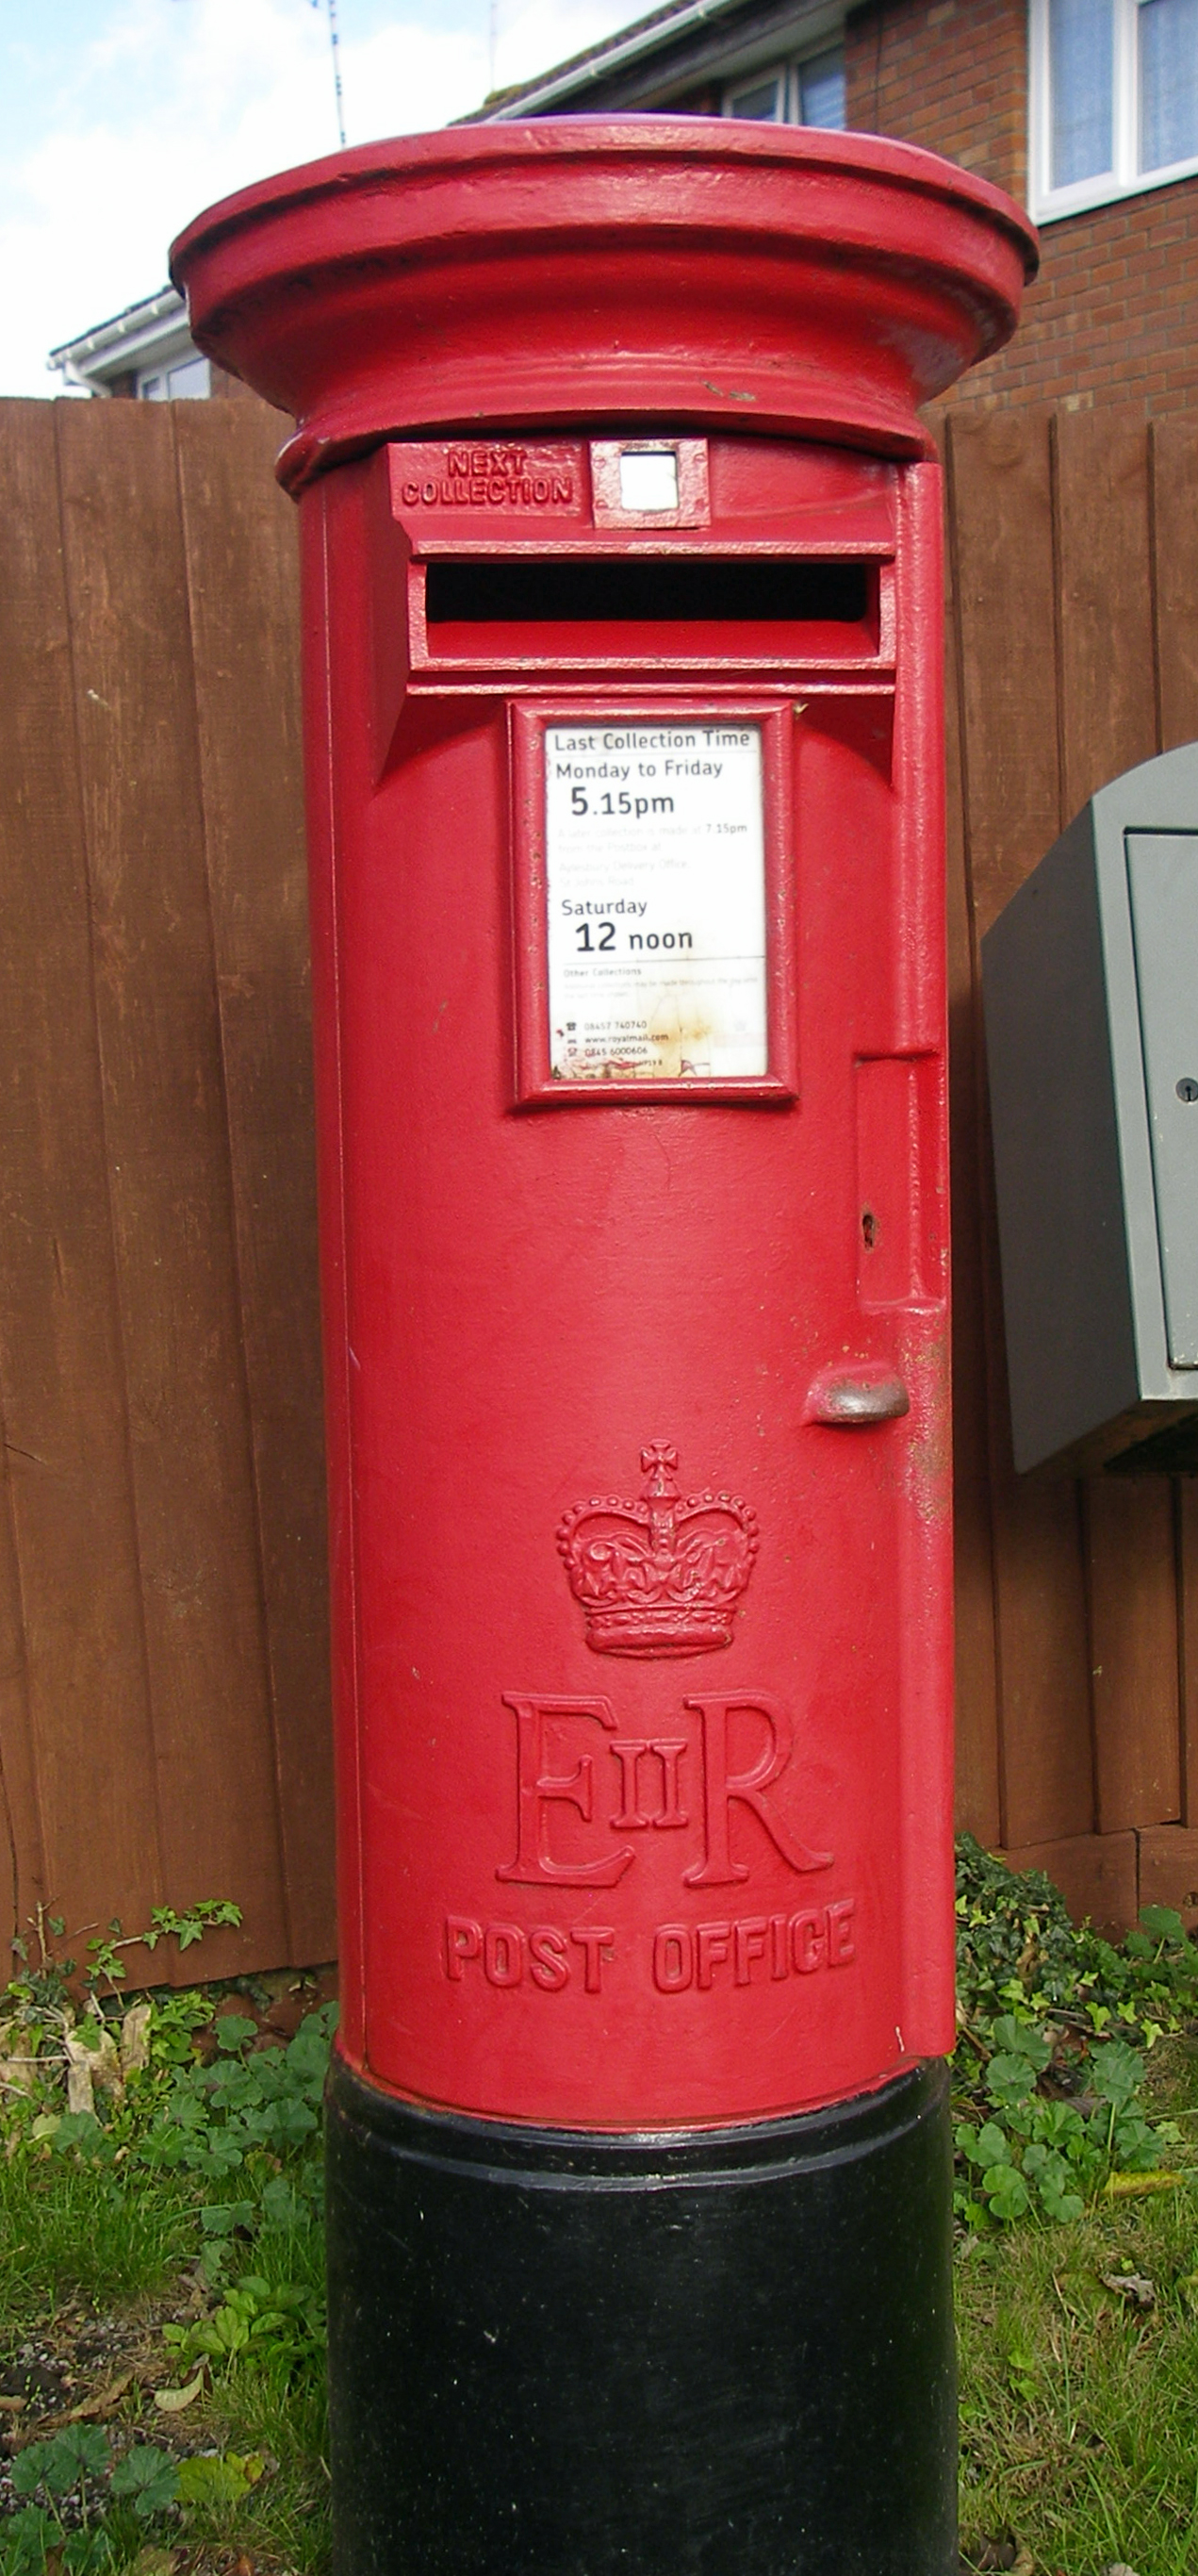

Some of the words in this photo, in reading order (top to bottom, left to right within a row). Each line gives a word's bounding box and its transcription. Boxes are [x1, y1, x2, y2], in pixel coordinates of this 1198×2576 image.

[449, 450, 527, 476] NEXT
[402, 476, 573, 506] COLLECTION
[554, 734, 596, 751] Last
[603, 732, 697, 750] Collection
[702, 730, 750, 748] Time
[556, 762, 631, 781] Monday
[638, 762, 656, 777] to
[665, 759, 723, 778] Friday
[571, 786, 675, 818] 5.15pm
[561, 899, 648, 916] Saturday
[575, 922, 616, 951] 12
[629, 932, 694, 949] noon
[564, 969, 588, 979] Other
[593, 967, 642, 977] Collections
[615, 1020, 648, 1030] 740740
[585, 1033, 669, 1044] www.royalmail.com
[610, 1047, 648, 1056] 6000606
[444, 1915, 615, 1994] POST
[652, 1898, 856, 1995] OFFICE
